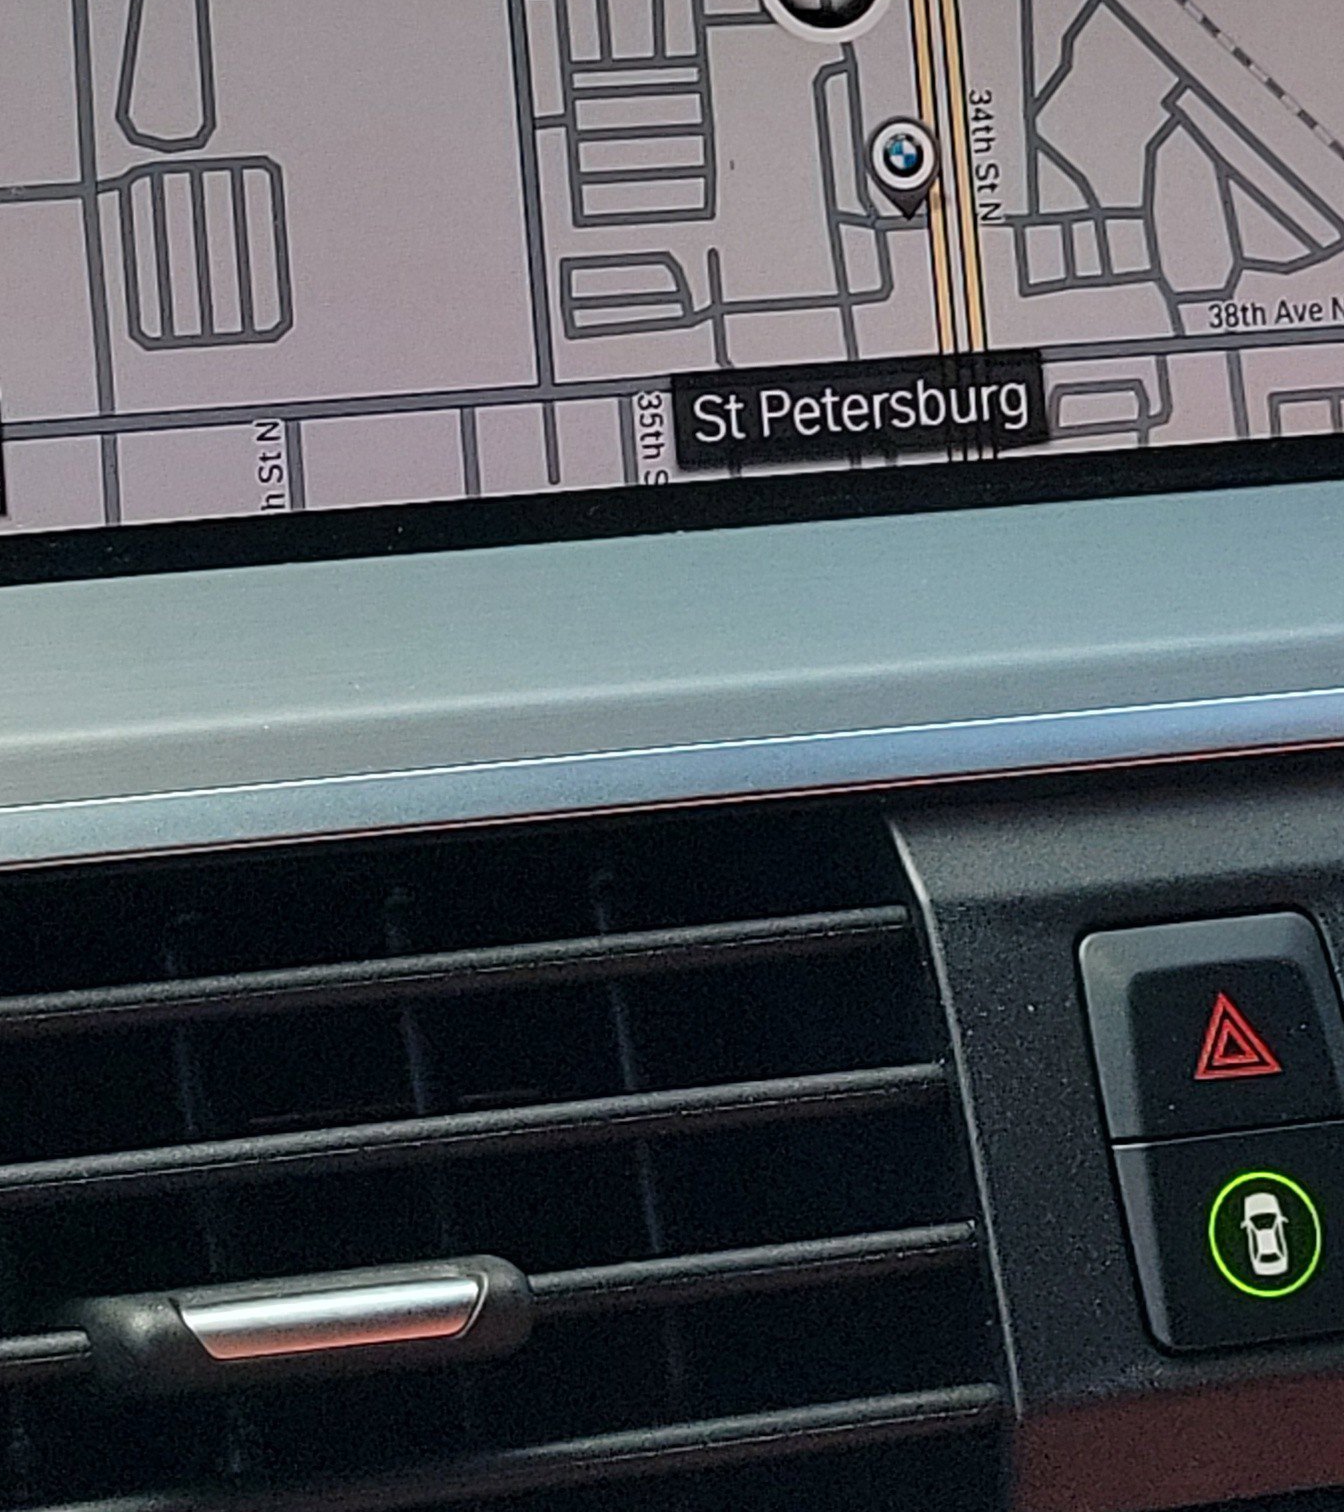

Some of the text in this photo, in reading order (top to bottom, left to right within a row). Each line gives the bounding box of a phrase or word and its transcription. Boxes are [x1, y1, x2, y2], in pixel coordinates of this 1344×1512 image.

[969, 89, 1002, 221] 34th St N
[1208, 302, 1266, 329] 38th
[1275, 299, 1323, 325] Ave
[255, 421, 281, 442] N
[692, 379, 1028, 442] St Petersburg
[637, 393, 669, 485] 35th S
[258, 452, 283, 483] St
